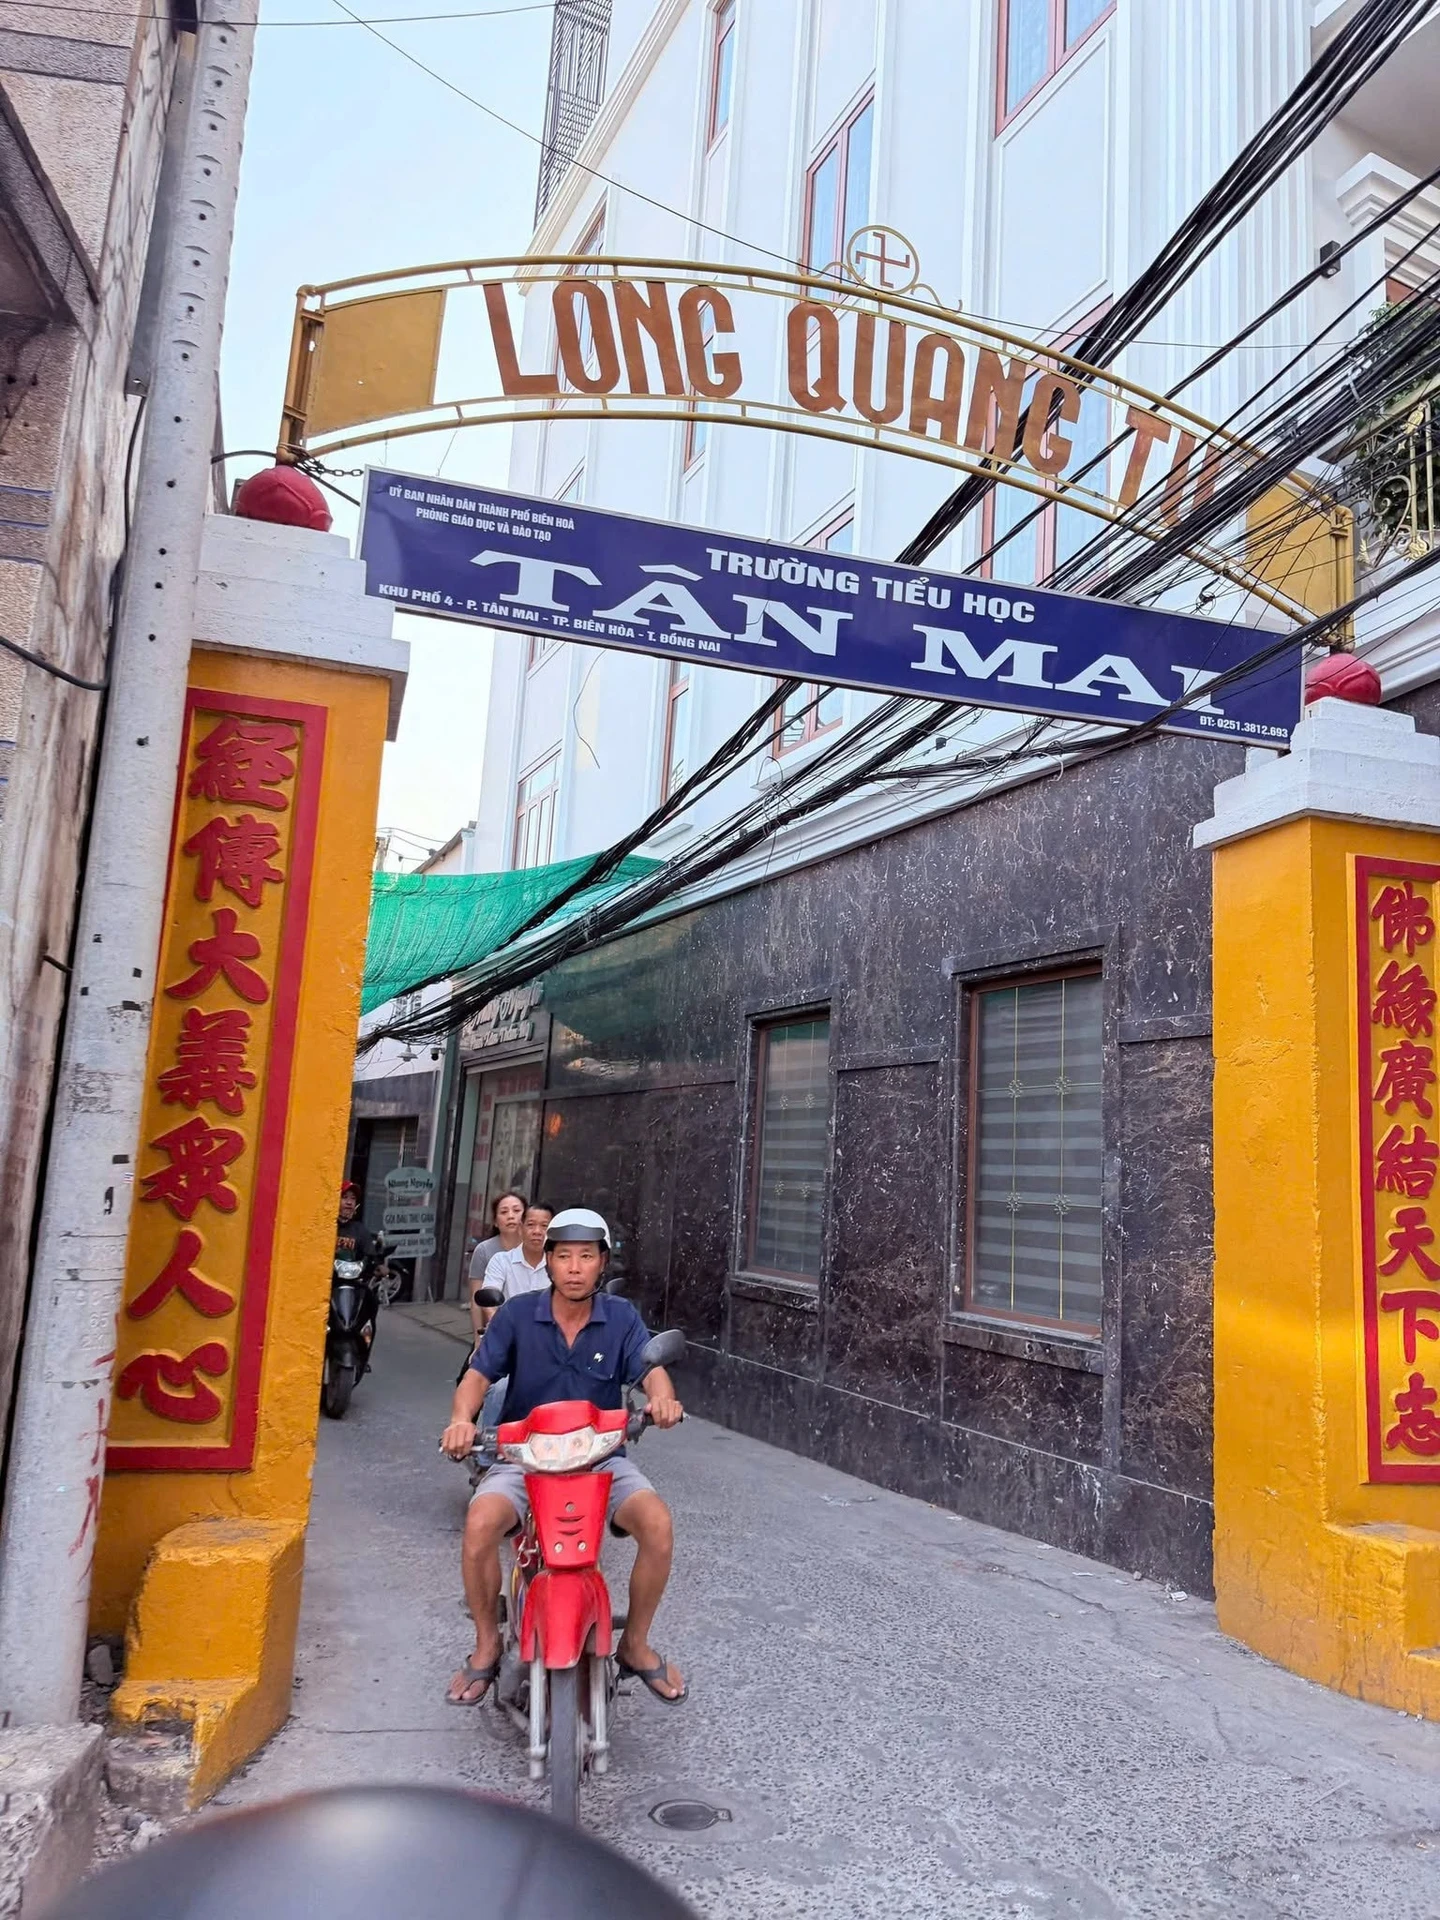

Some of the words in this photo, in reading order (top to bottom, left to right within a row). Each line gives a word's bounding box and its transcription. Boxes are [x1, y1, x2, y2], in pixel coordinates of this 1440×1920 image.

[483, 280, 742, 399] LONG
[787, 300, 1081, 475] QUANG
[404, 489, 425, 502] BAN
[426, 493, 455, 508] NHÂN
[455, 498, 477, 512] DÂN
[478, 502, 509, 518] THÀNH
[510, 508, 531, 522] PHỐ
[531, 512, 554, 527] BIÊN
[555, 517, 575, 530] HOÀ
[416, 507, 450, 523] PHÒNG
[451, 513, 474, 528] GIÁO
[475, 518, 496, 532] DỤC
[497, 521, 510, 535] VÀ
[512, 524, 532, 538] ĐÀO
[533, 528, 552, 543] TẠO
[378, 583, 409, 598] KHU
[411, 590, 442, 604] PHỐ
[443, 595, 453, 606] 4
[466, 599, 478, 611] P.
[482, 601, 510, 617] TÂN
[512, 608, 540, 622] MAI
[552, 614, 569, 628] TP.
[573, 619, 606, 634] BIÊN
[608, 624, 636, 639] HÒA
[647, 631, 657, 642] T.
[698, 640, 721, 653] NAI
[706, 547, 860, 595] TRƯỜNG
[871, 577, 952, 610] TIỂU
[962, 593, 1036, 624] HỌC
[469, 549, 853, 657] TÂN
[910, 623, 1225, 715] MAI
[1217, 718, 1289, 738] 0251.3812.693
